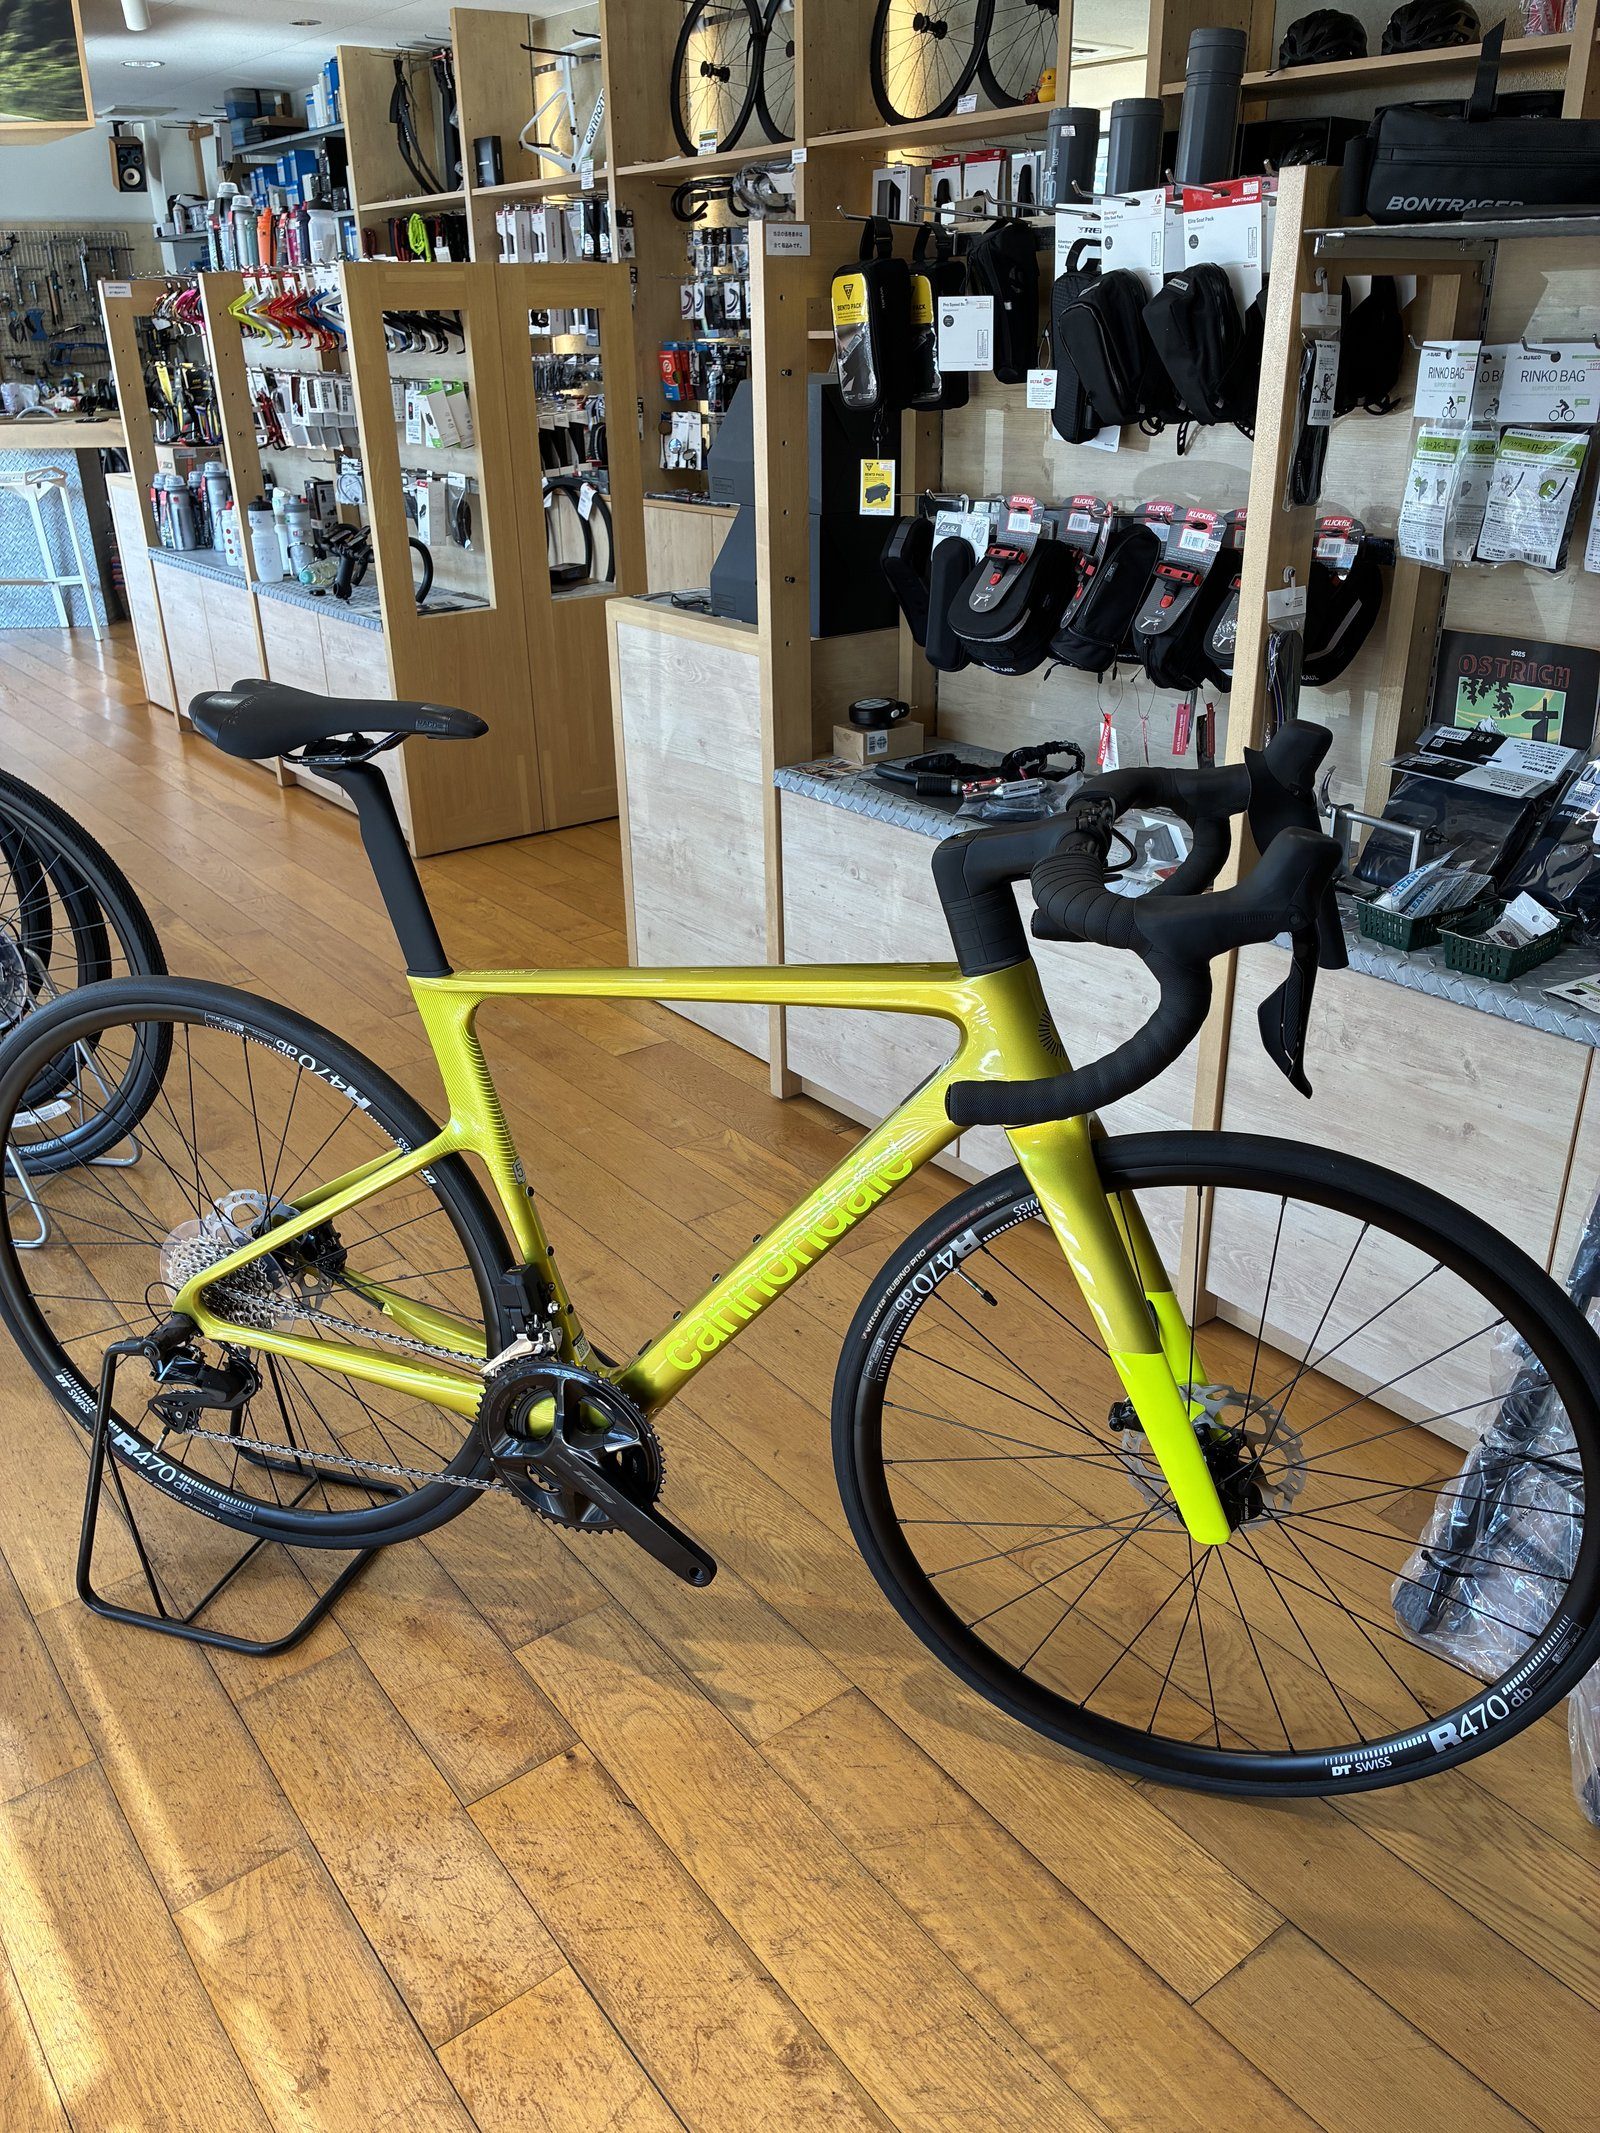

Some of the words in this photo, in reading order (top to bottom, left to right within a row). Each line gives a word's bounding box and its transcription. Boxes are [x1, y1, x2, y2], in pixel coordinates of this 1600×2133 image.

[585, 88, 605, 145] cannon
[1205, 215, 1214, 223] Pack
[836, 304, 851, 312] BENTO
[1428, 366, 1449, 379] RINKO
[1449, 367, 1465, 380] BAG
[1520, 370, 1558, 383] RINKO
[1559, 370, 1586, 383] BAG
[1011, 496, 1036, 506] KLICKfix
[1073, 497, 1096, 506] KLICKfix
[1147, 504, 1174, 513] KLICKfix
[1188, 510, 1217, 522] KLICKfix
[1323, 519, 1352, 529] KLICKfix
[1510, 649, 1526, 658] 2025
[1458, 653, 1571, 689] OSTRICH
[275, 1038, 298, 1057] db
[298, 1053, 372, 1111] R470
[396, 1137, 412, 1155] ISS
[515, 1162, 524, 1178] 5
[1012, 1196, 1040, 1218] WISS
[664, 1150, 913, 1371] cannondale
[911, 1228, 983, 1297] R470
[886, 1265, 911, 1297] RUBINO
[910, 1248, 928, 1268] PRO
[894, 1287, 915, 1312] db
[55, 1373, 72, 1388] DT
[67, 1388, 93, 1415] SWISS
[112, 1431, 177, 1484] R470
[173, 1480, 193, 1496] db
[153, 1482, 182, 1501] RUBINO
[1331, 1763, 1352, 1777] DT
[1355, 1755, 1393, 1774] SWISS
[1428, 1693, 1510, 1754] R470
[1509, 1684, 1534, 1709] db
